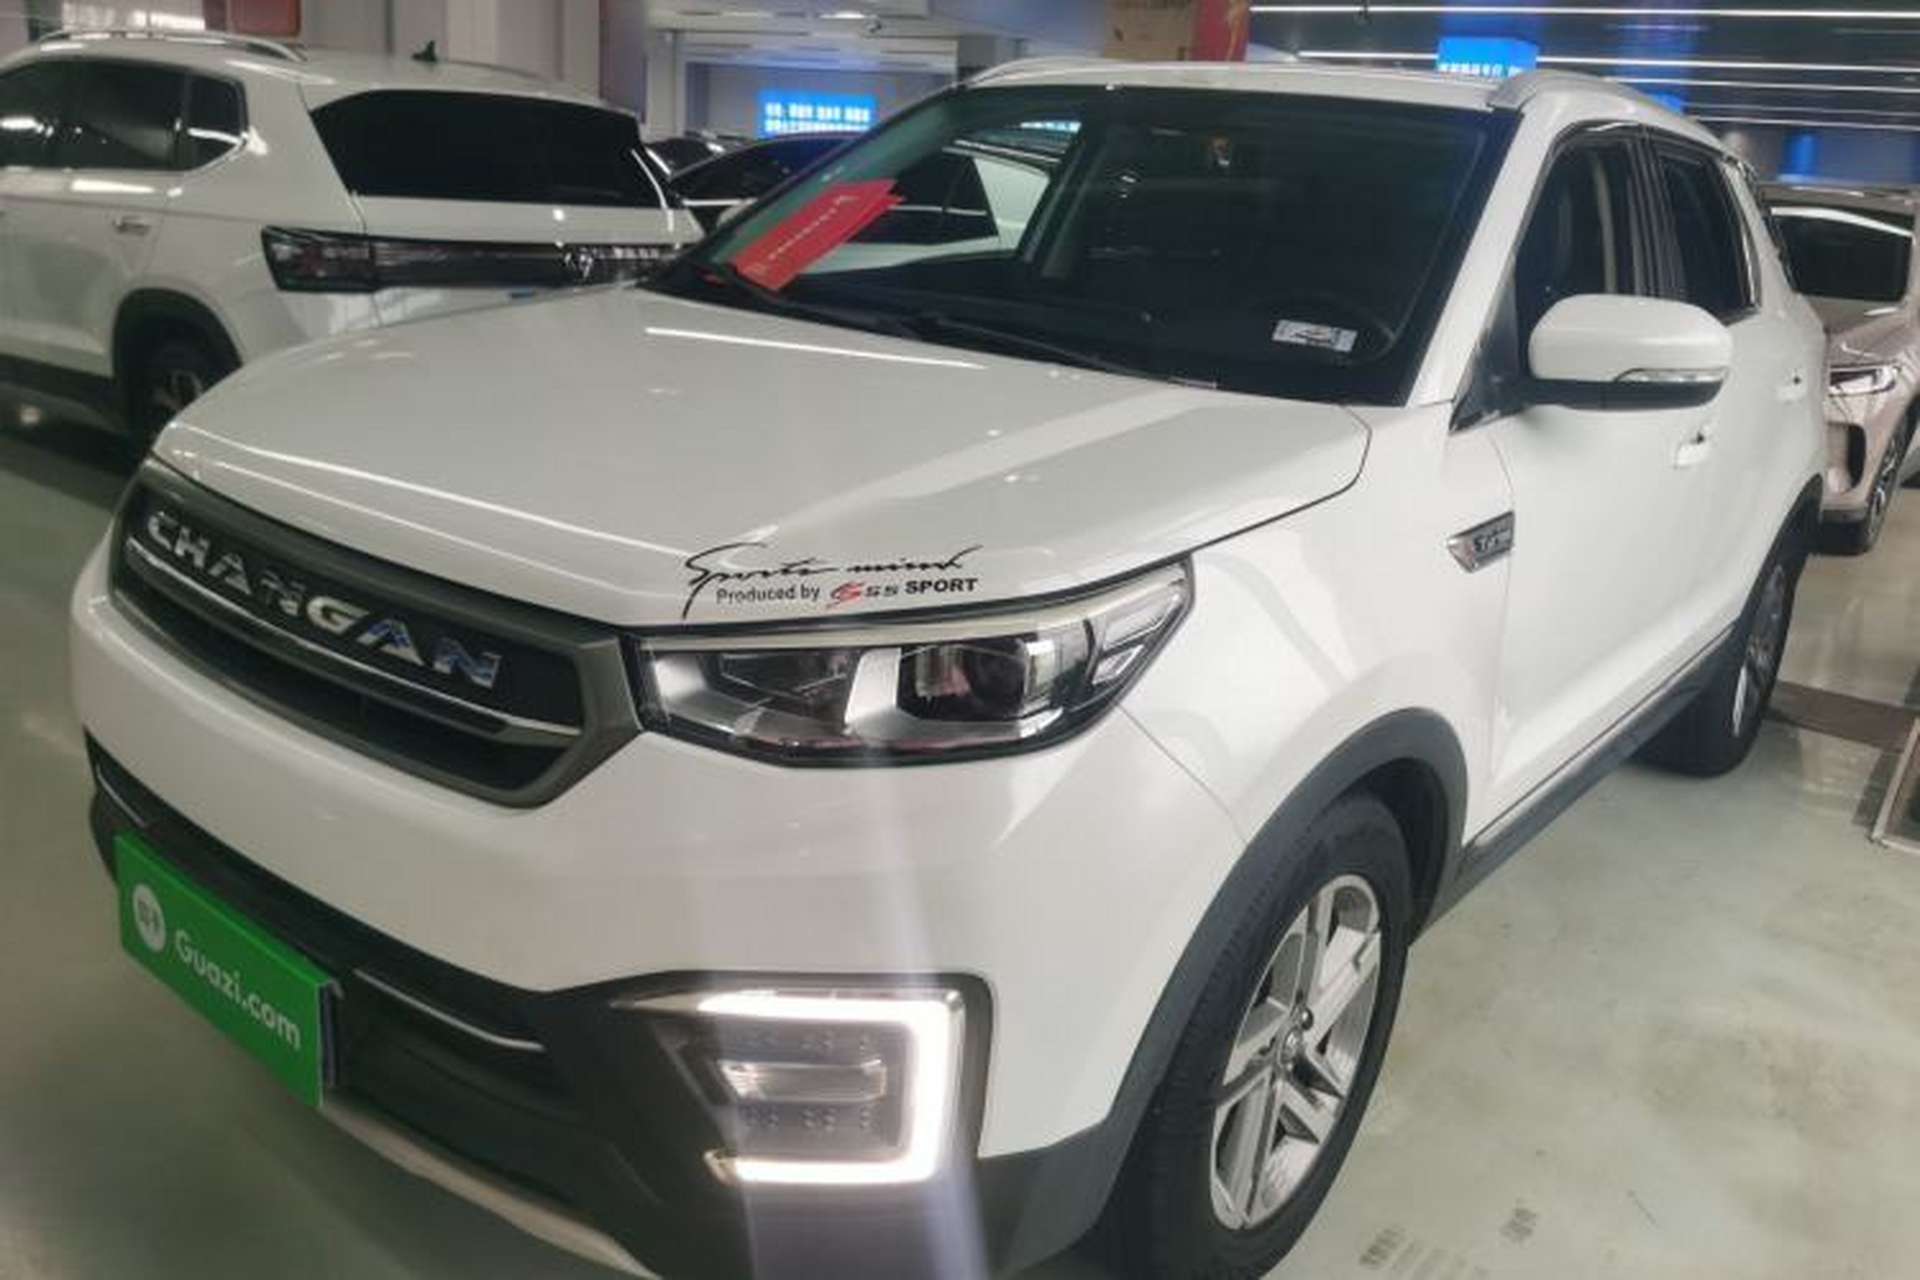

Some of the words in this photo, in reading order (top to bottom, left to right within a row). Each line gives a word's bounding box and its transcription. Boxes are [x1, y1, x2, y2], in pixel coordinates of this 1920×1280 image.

[148, 509, 502, 689] CHANGAN
[716, 584, 796, 605] Produced
[800, 582, 821, 602] by
[905, 577, 978, 594] SPORT
[174, 929, 302, 1051] Guazi.com
